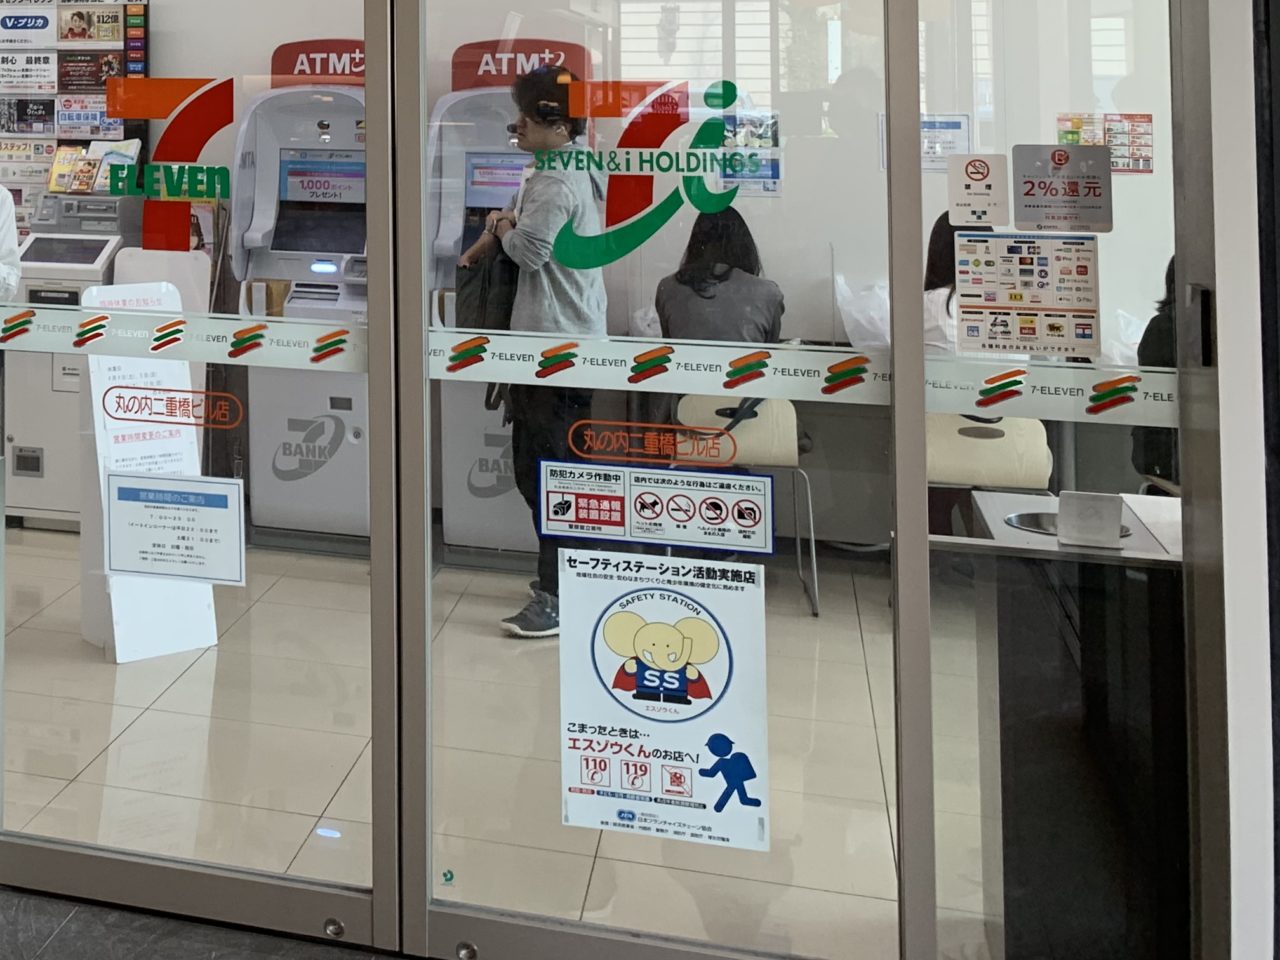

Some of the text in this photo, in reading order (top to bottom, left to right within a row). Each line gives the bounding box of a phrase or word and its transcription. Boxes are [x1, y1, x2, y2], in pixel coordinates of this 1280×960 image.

[638, 151, 761, 174] HOLDINGS
[1023, 179, 1102, 198] 2%還元
[1143, 391, 1175, 402] 7-ELE
[114, 393, 230, 422] 丸の内二重橋ビル店
[282, 442, 330, 459] BANK
[583, 428, 721, 458] 丸の内二重橋ビル店
[478, 457, 515, 474] BAN
[549, 469, 621, 482] 防犯カメラ作動中
[566, 556, 756, 585] セーフティステーション活動実施店
[618, 592, 702, 617] SAFETY STATION
[644, 704, 680, 715] エスゾウくん
[583, 757, 648, 777] 110 119
